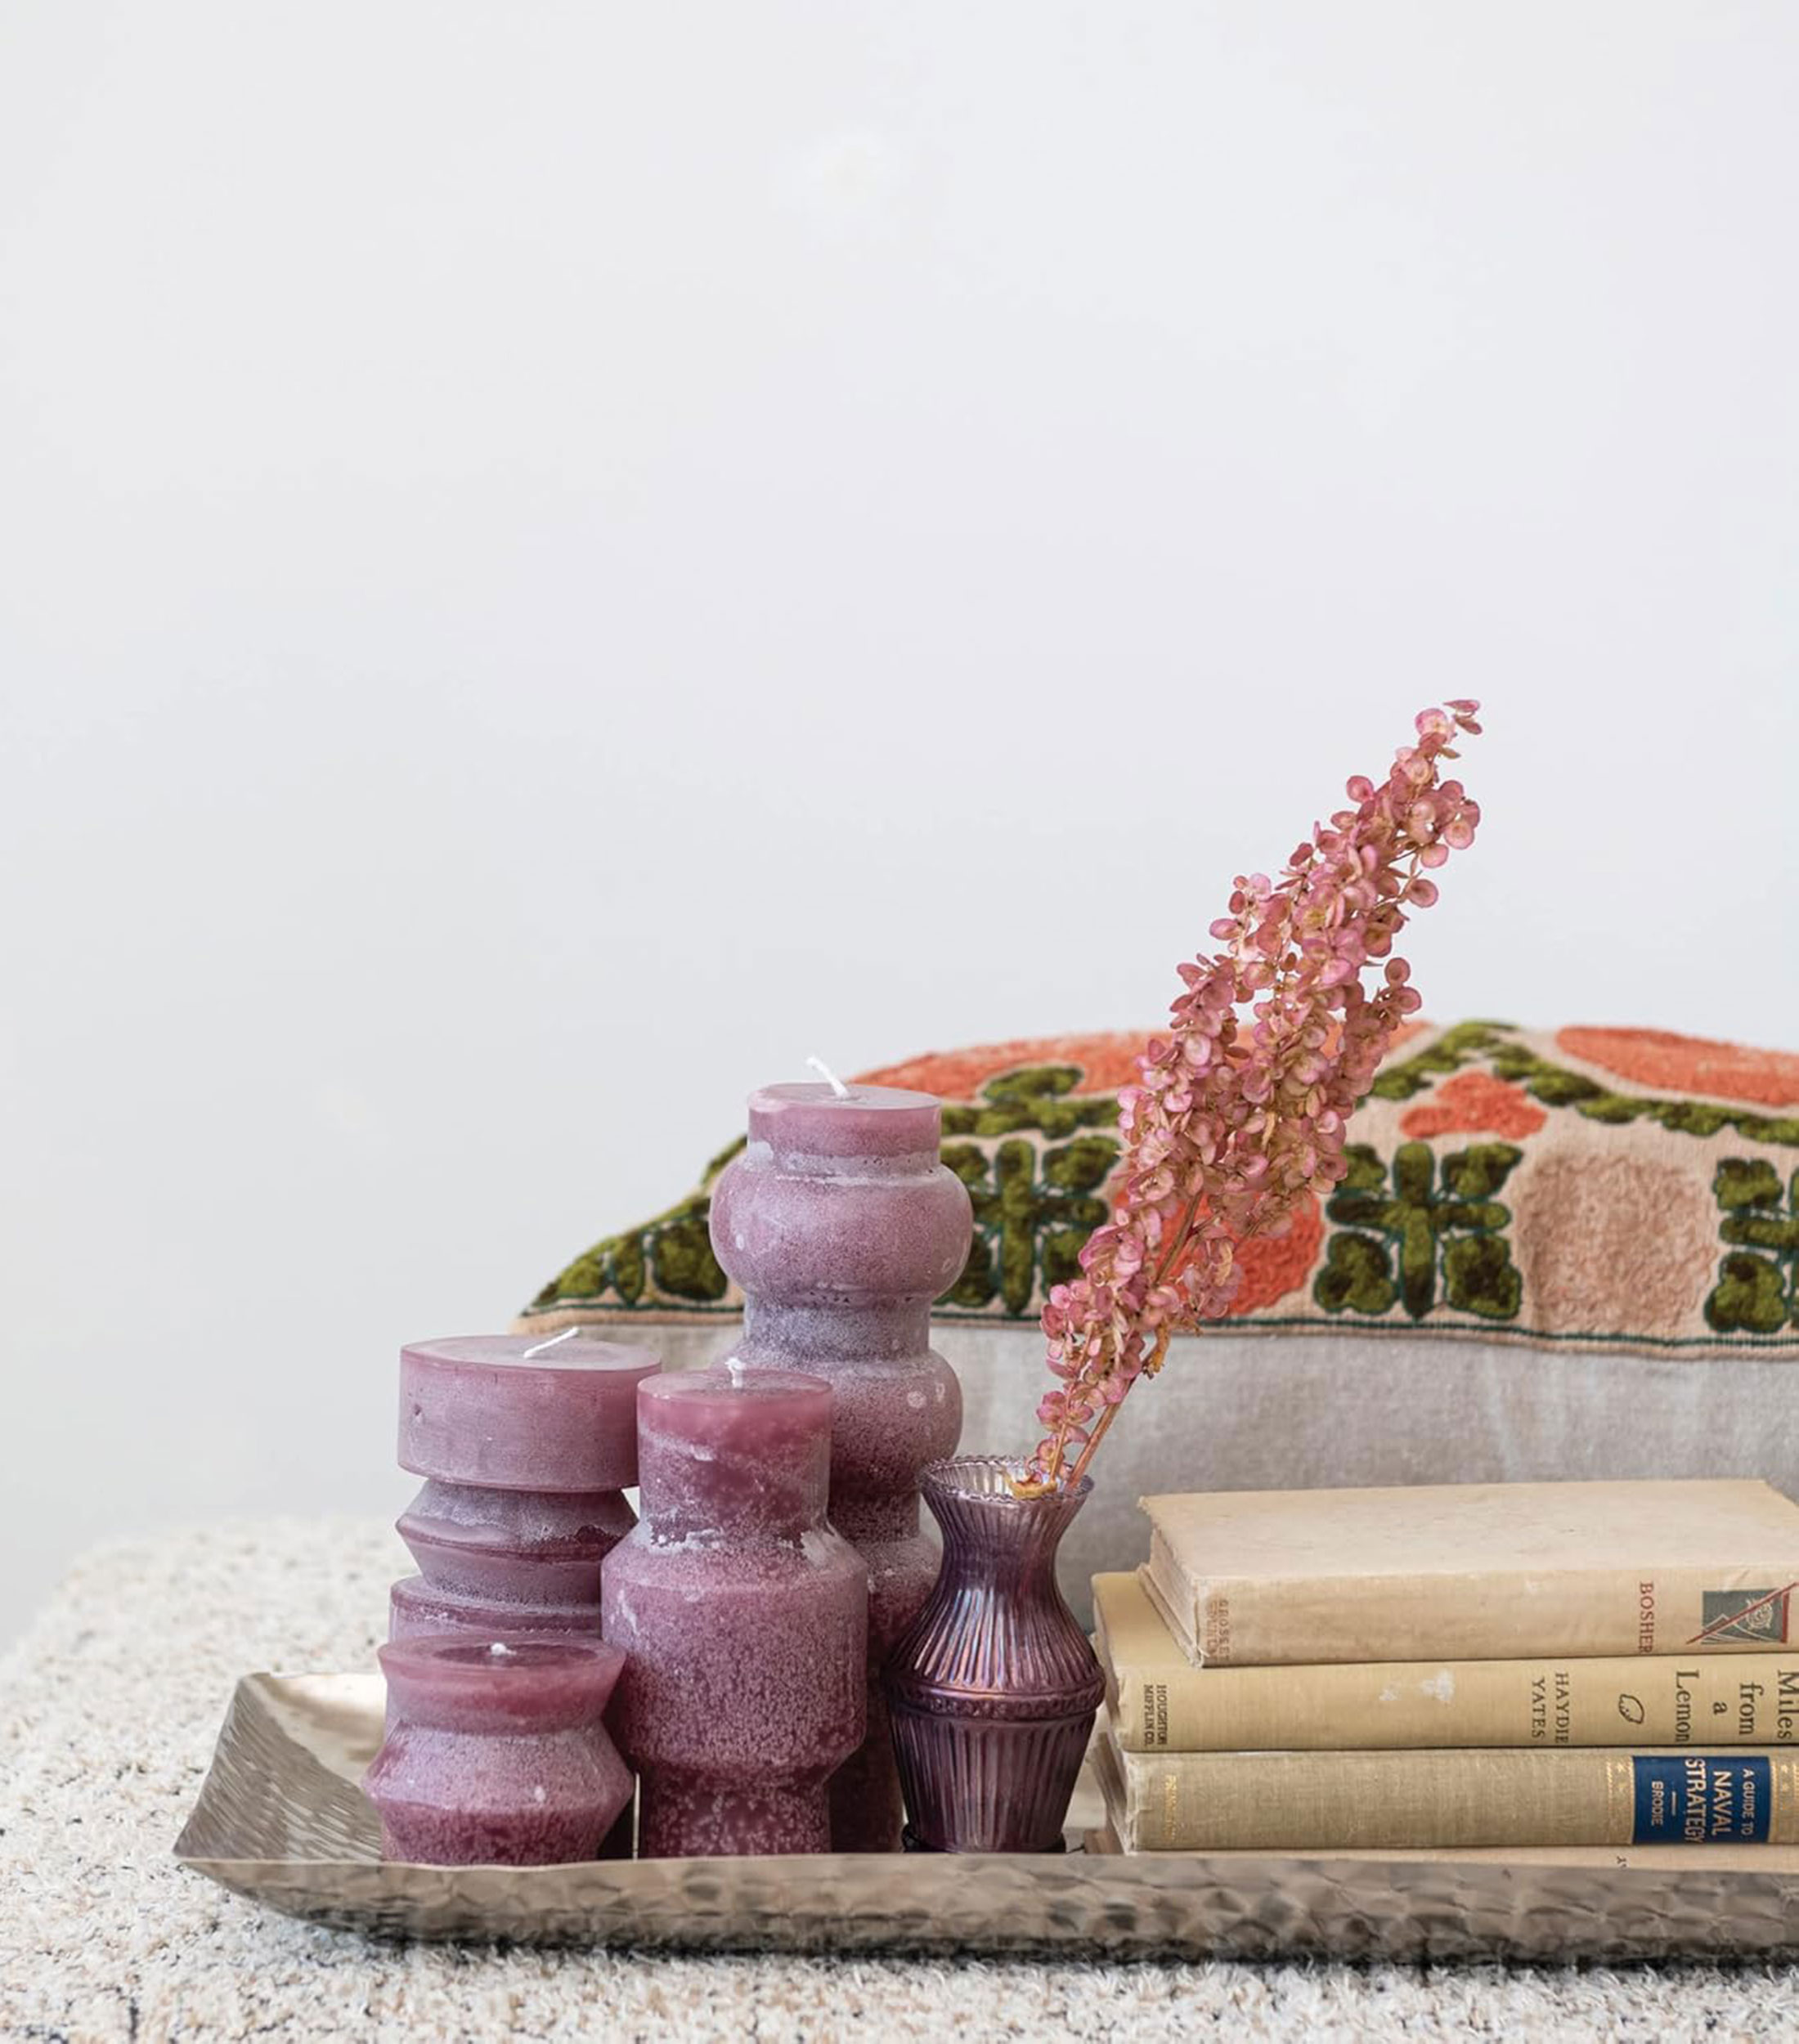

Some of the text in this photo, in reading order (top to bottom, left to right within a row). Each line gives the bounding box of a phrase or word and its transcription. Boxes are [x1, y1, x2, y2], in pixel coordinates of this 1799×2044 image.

[1638, 1580, 1654, 1654] BOSHER
[1143, 1684, 1155, 1729] MIFFLIN
[1156, 1684, 1168, 1745] HOUGHTON
[1532, 1677, 1546, 1738] YATES
[1554, 1672, 1570, 1744] HAYDIE
[1675, 1670, 1699, 1743] Lemon
[1713, 1701, 1729, 1715] a
[1738, 1682, 1764, 1736] from
[1777, 1670, 1799, 1740] Miles
[1650, 1781, 1664, 1826] BRODIE
[1684, 1758, 1707, 1844] STRATEGY
[1712, 1771, 1734, 1836] NAVAL
[1741, 1768, 1756, 1836] A GUIDE TO
